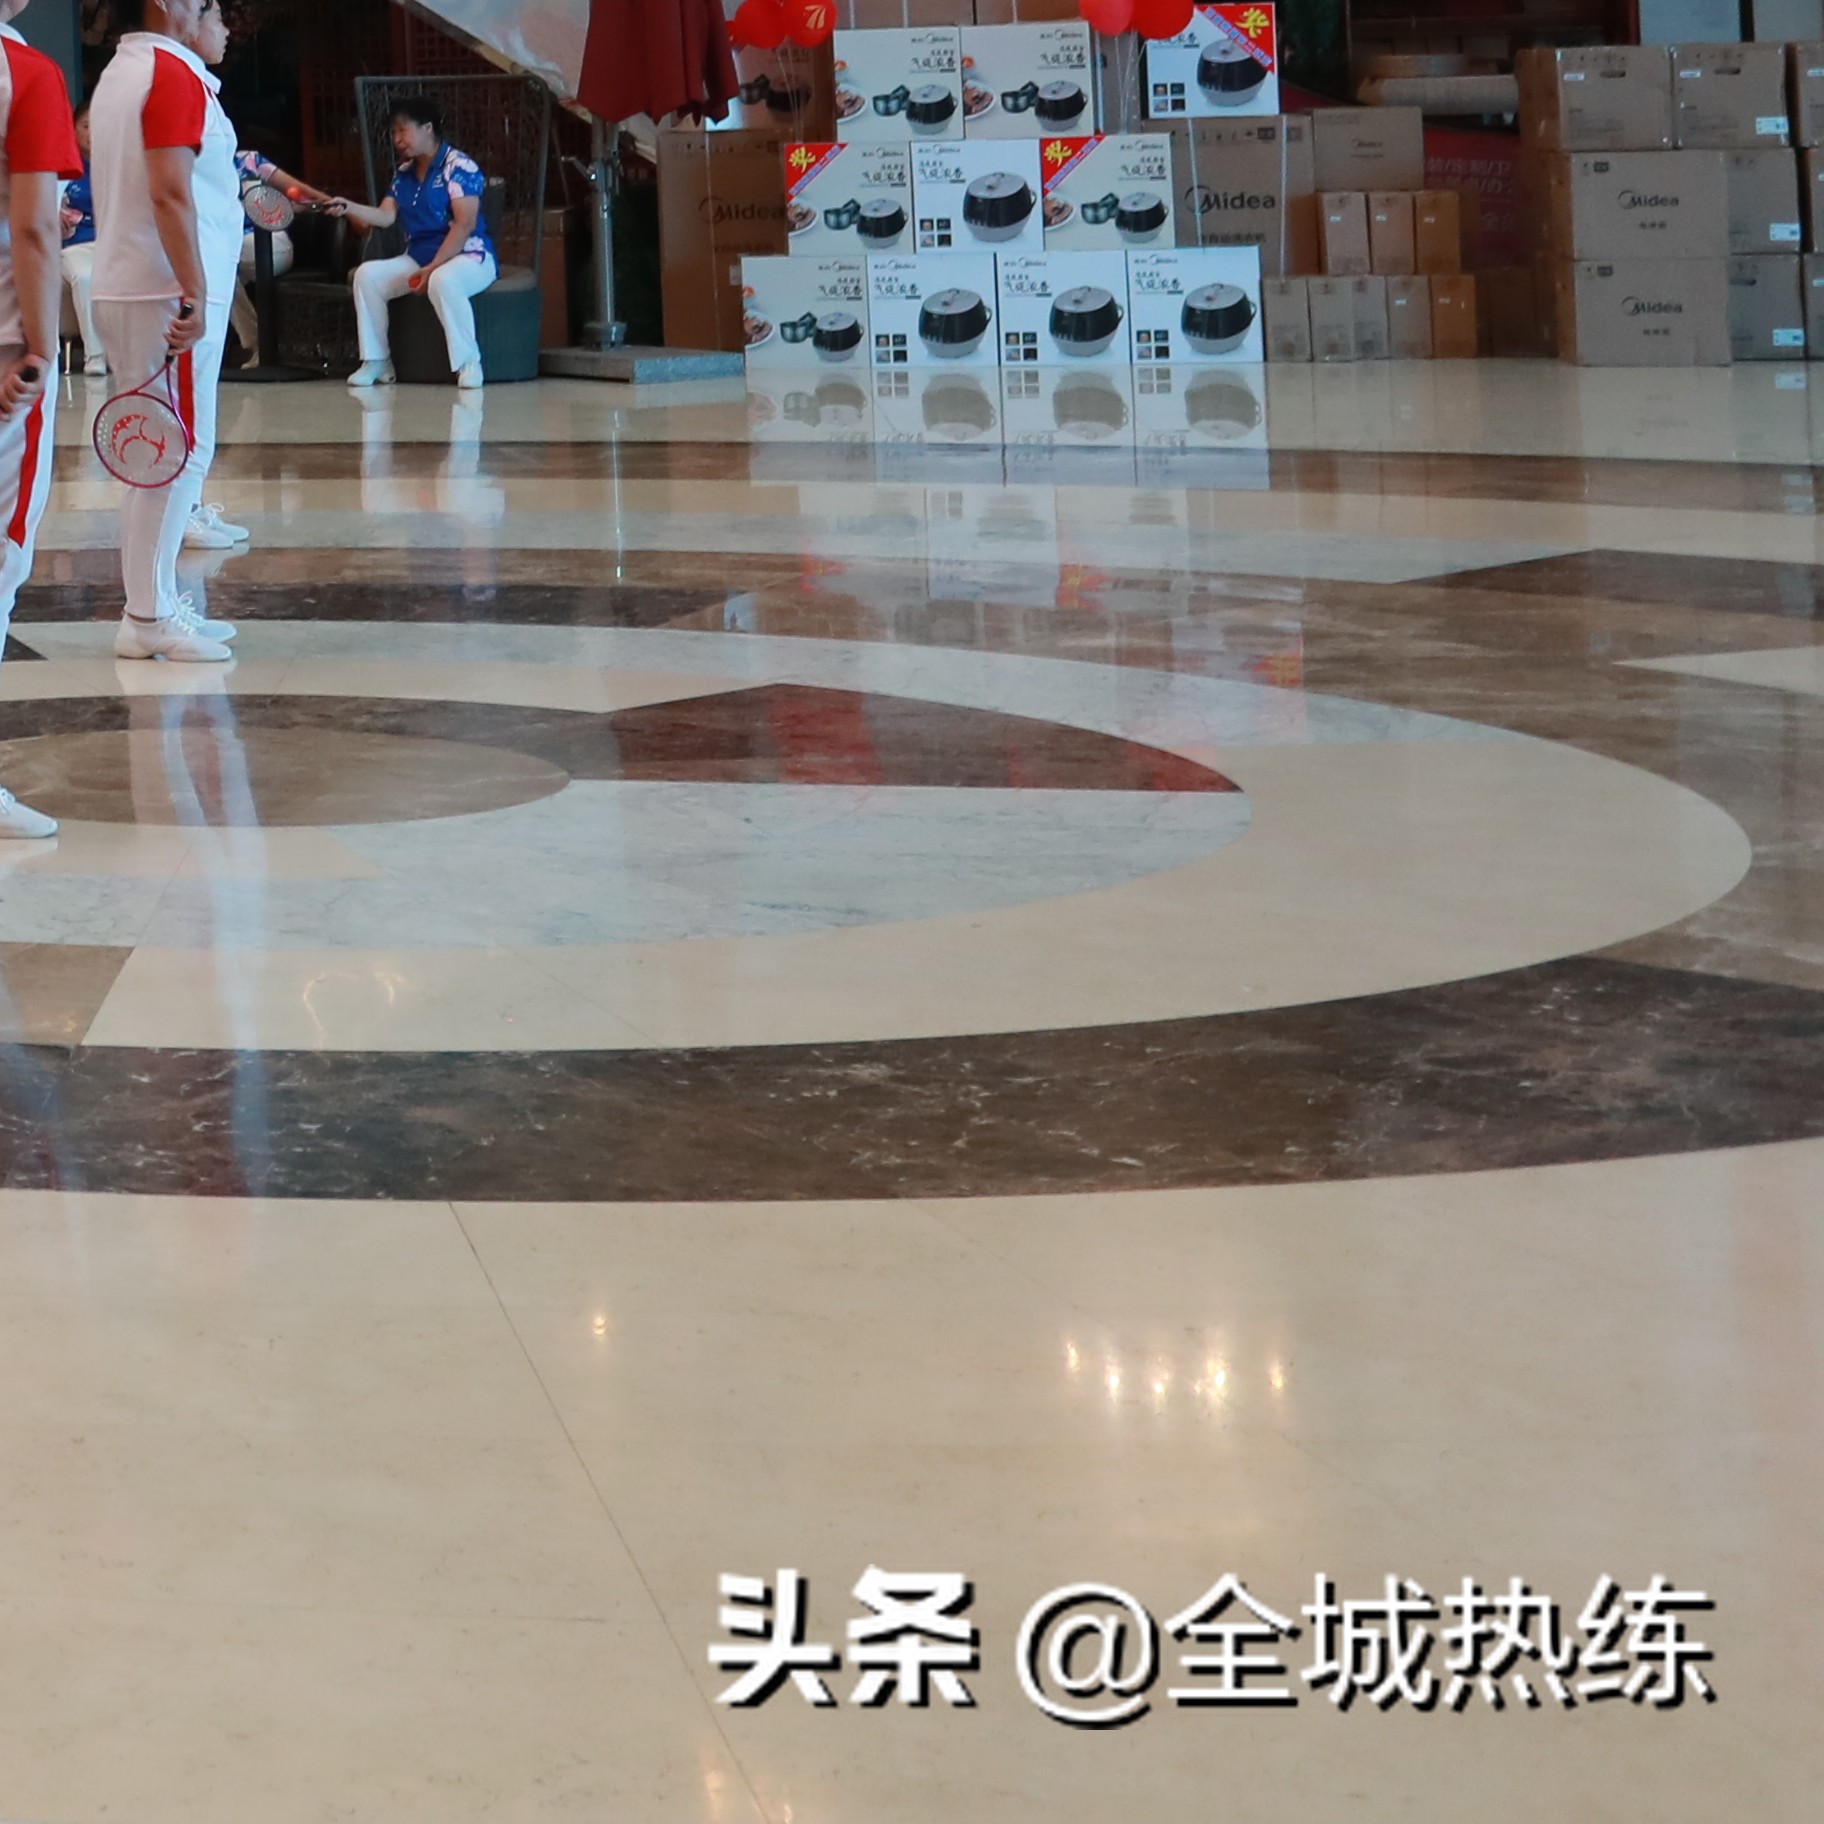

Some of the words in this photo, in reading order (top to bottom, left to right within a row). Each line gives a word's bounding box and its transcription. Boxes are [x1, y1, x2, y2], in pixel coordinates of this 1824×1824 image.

[1184, 185, 1276, 215] Midea
[1618, 189, 1680, 210] Midea
[1622, 295, 1683, 316] Midea
